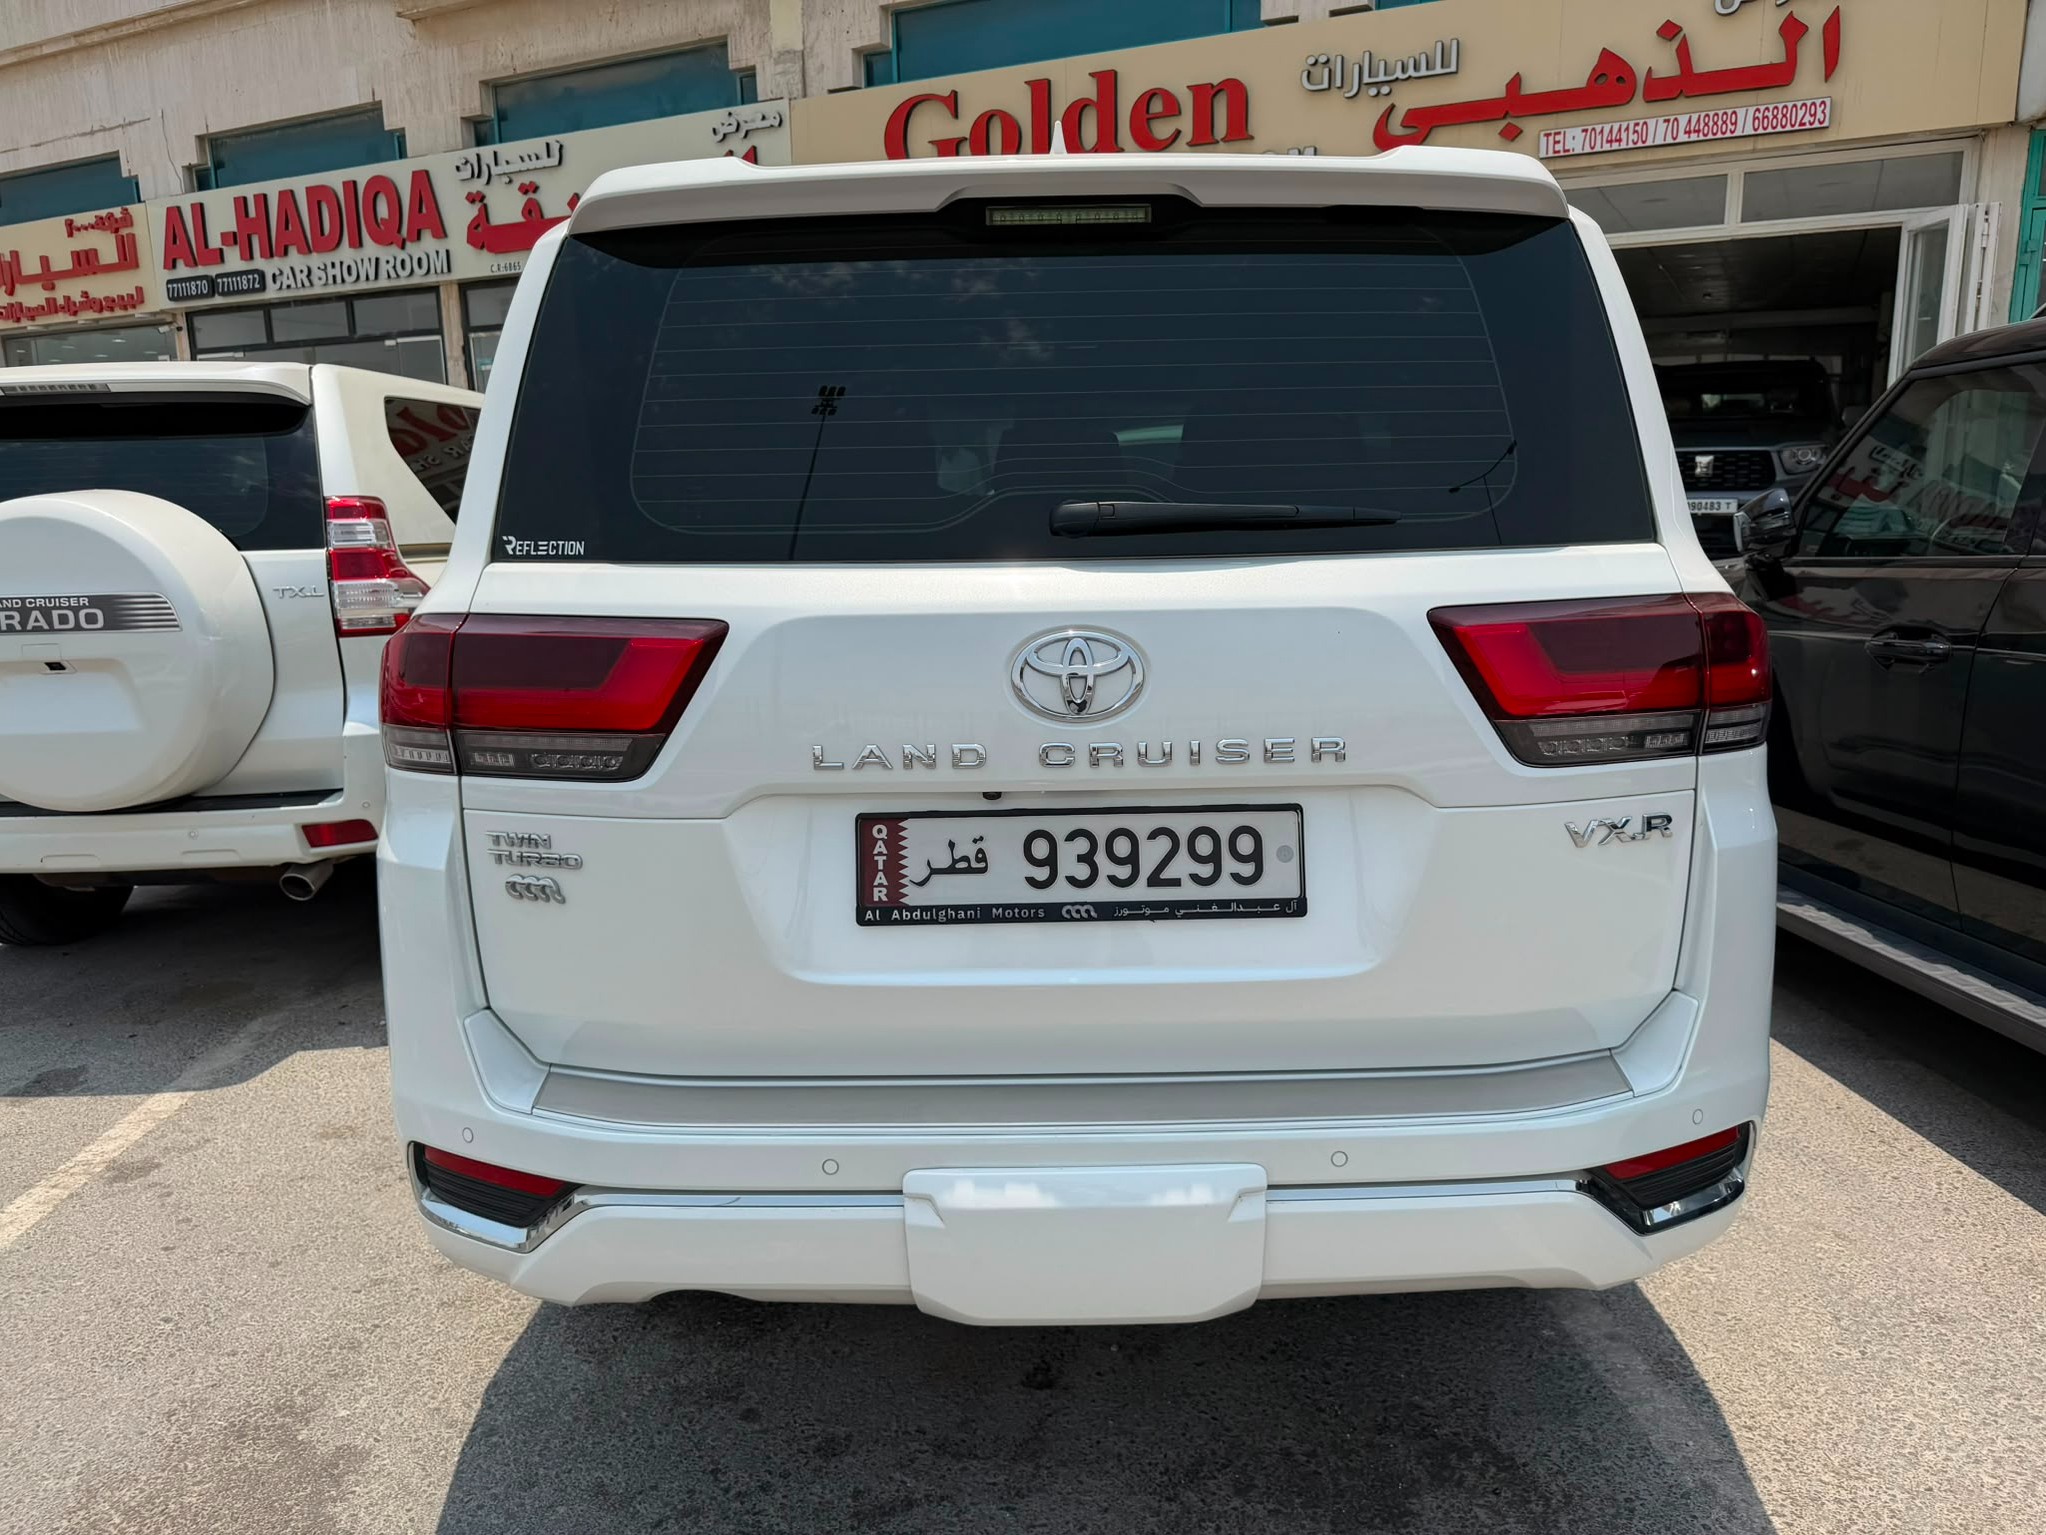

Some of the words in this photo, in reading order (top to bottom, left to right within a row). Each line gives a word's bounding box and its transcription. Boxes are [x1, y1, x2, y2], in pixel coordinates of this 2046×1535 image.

[1300, 38, 1460, 99] للسيارات
[711, 111, 783, 143] معرض
[884, 69, 1255, 160] Golden
[1543, 130, 1576, 156] TEL:
[1581, 121, 1649, 152] 70144150
[1663, 117, 1680, 142] 70
[1683, 110, 1738, 139] 448889
[1752, 100, 1827, 132] 66880293
[455, 140, 563, 186] للسيارات
[163, 169, 447, 270] AL-HADIQA
[167, 279, 209, 298] 77111870
[217, 273, 261, 293] 77111872
[271, 264, 313, 291] CAR
[502, 535, 585, 555] REFLECTION
[26, 597, 90, 607] CRUISER
[811, 742, 988, 771] LAND
[1038, 736, 1347, 769] CRUISER
[485, 831, 552, 849] TWIN
[486, 848, 583, 870] TURBO
[872, 824, 889, 902] QATAR
[909, 836, 989, 887] قطر
[1023, 825, 1264, 890] 939299
[864, 910, 880, 922] Al
[891, 907, 981, 922] Abdulghani
[992, 907, 1046, 919] Motors
[1113, 904, 1170, 917] موتورز
